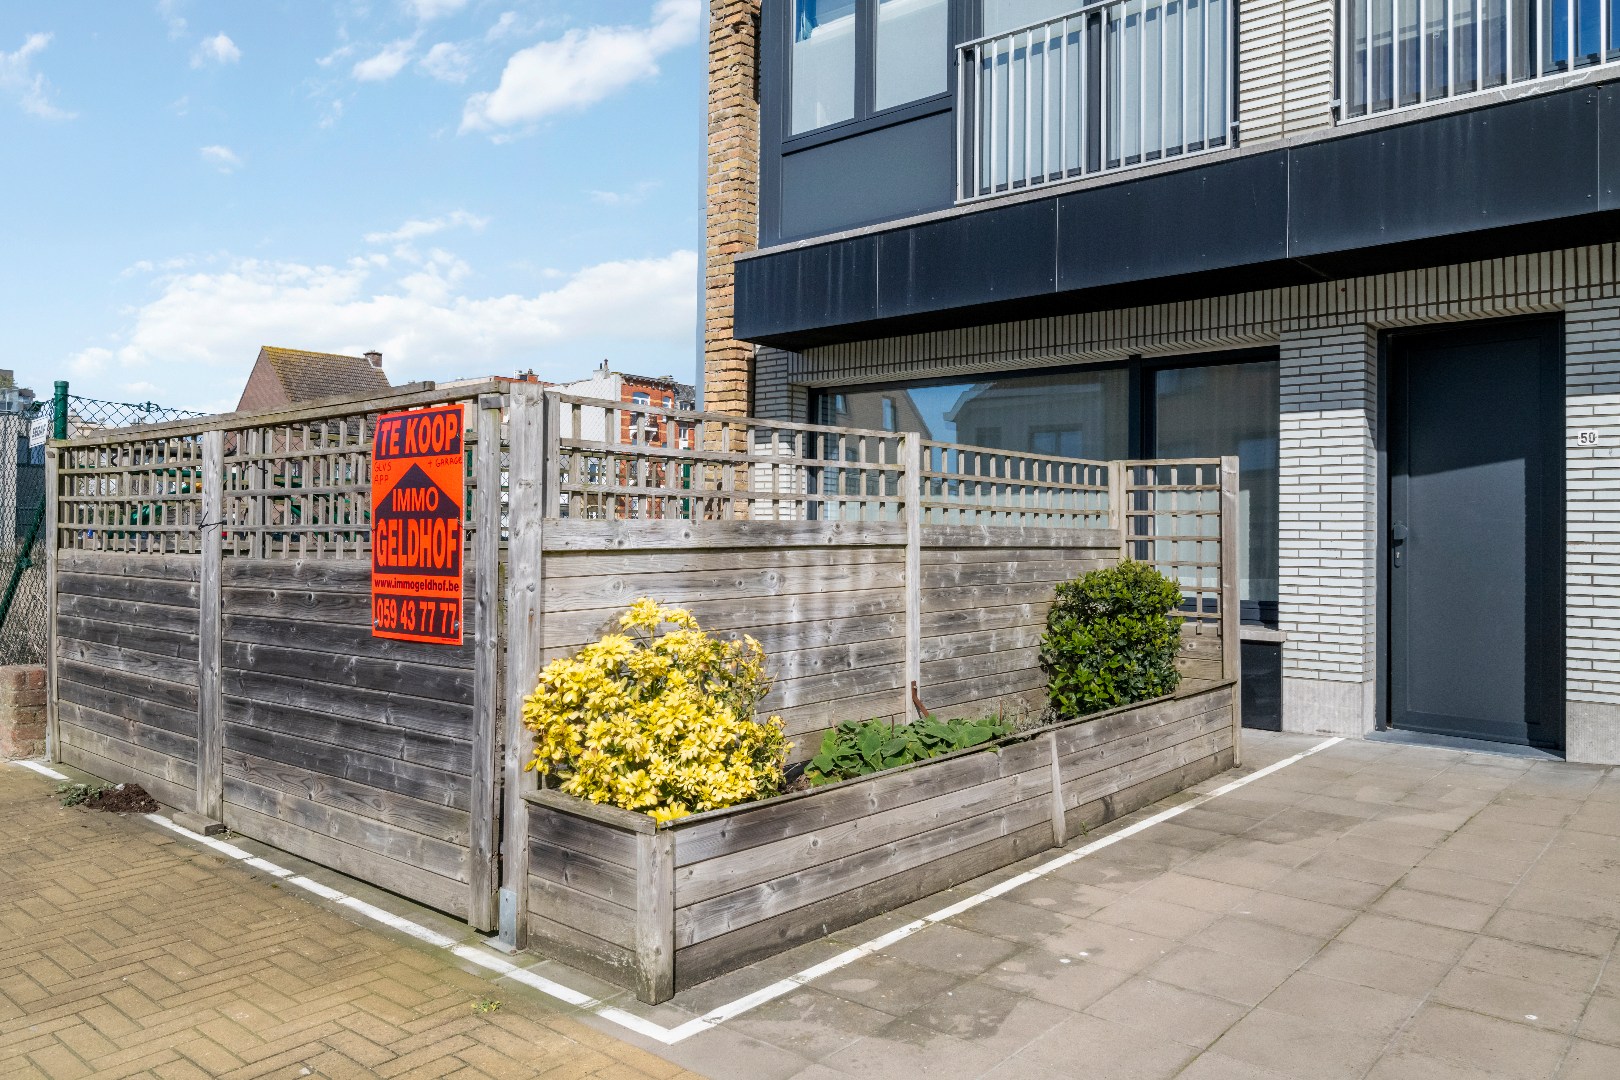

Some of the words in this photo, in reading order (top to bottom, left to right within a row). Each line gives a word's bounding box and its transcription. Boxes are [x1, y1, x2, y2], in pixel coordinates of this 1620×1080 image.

[380, 420, 402, 456] TE
[405, 413, 458, 454] KOOP
[1580, 432, 1596, 444] 50
[435, 457, 463, 468] GARAGE
[392, 486, 439, 512] IMMO
[376, 517, 459, 569] GELDHOF
[374, 577, 460, 593] www.immogeldhof.be
[376, 598, 398, 629] 059
[400, 600, 416, 631] 43
[419, 601, 436, 633] 77
[439, 602, 457, 635] 77
